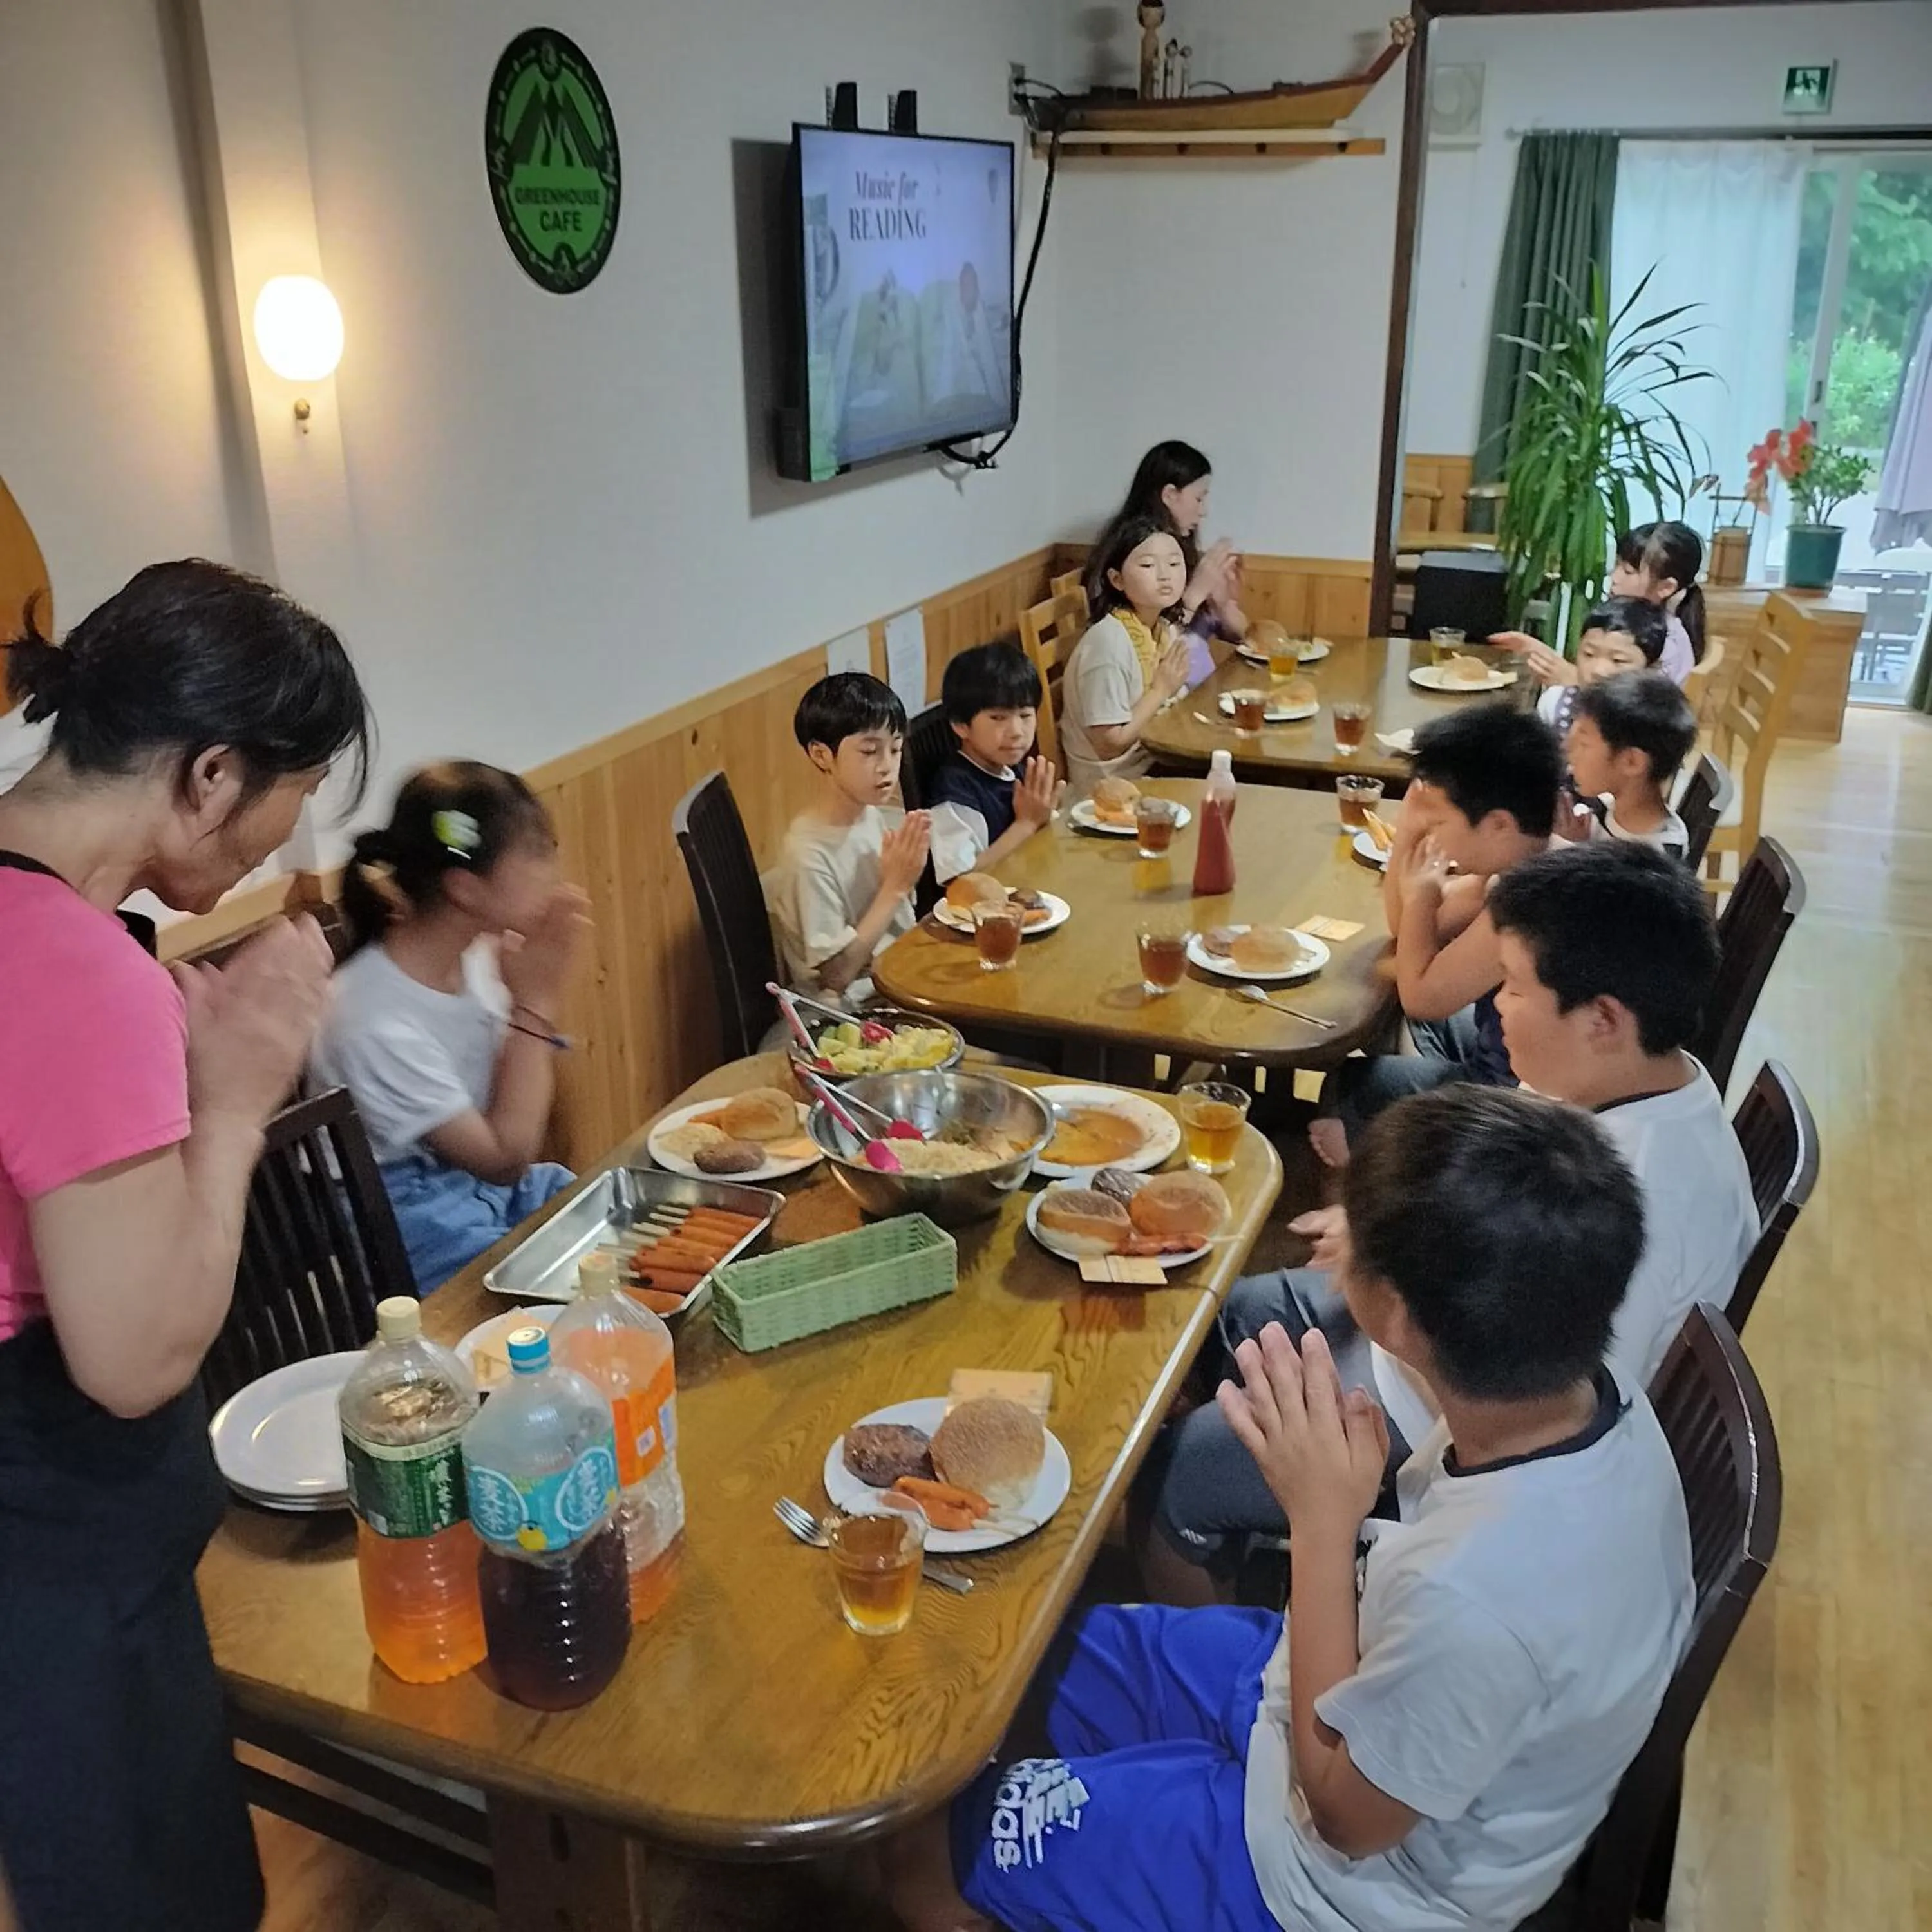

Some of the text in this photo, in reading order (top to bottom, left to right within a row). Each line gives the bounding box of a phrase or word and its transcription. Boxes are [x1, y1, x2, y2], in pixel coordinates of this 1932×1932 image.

[515, 187, 600, 206] GREENHOUSE
[855, 170, 919, 205] Music for
[540, 211, 582, 232] CAFE
[848, 207, 927, 241] READING
